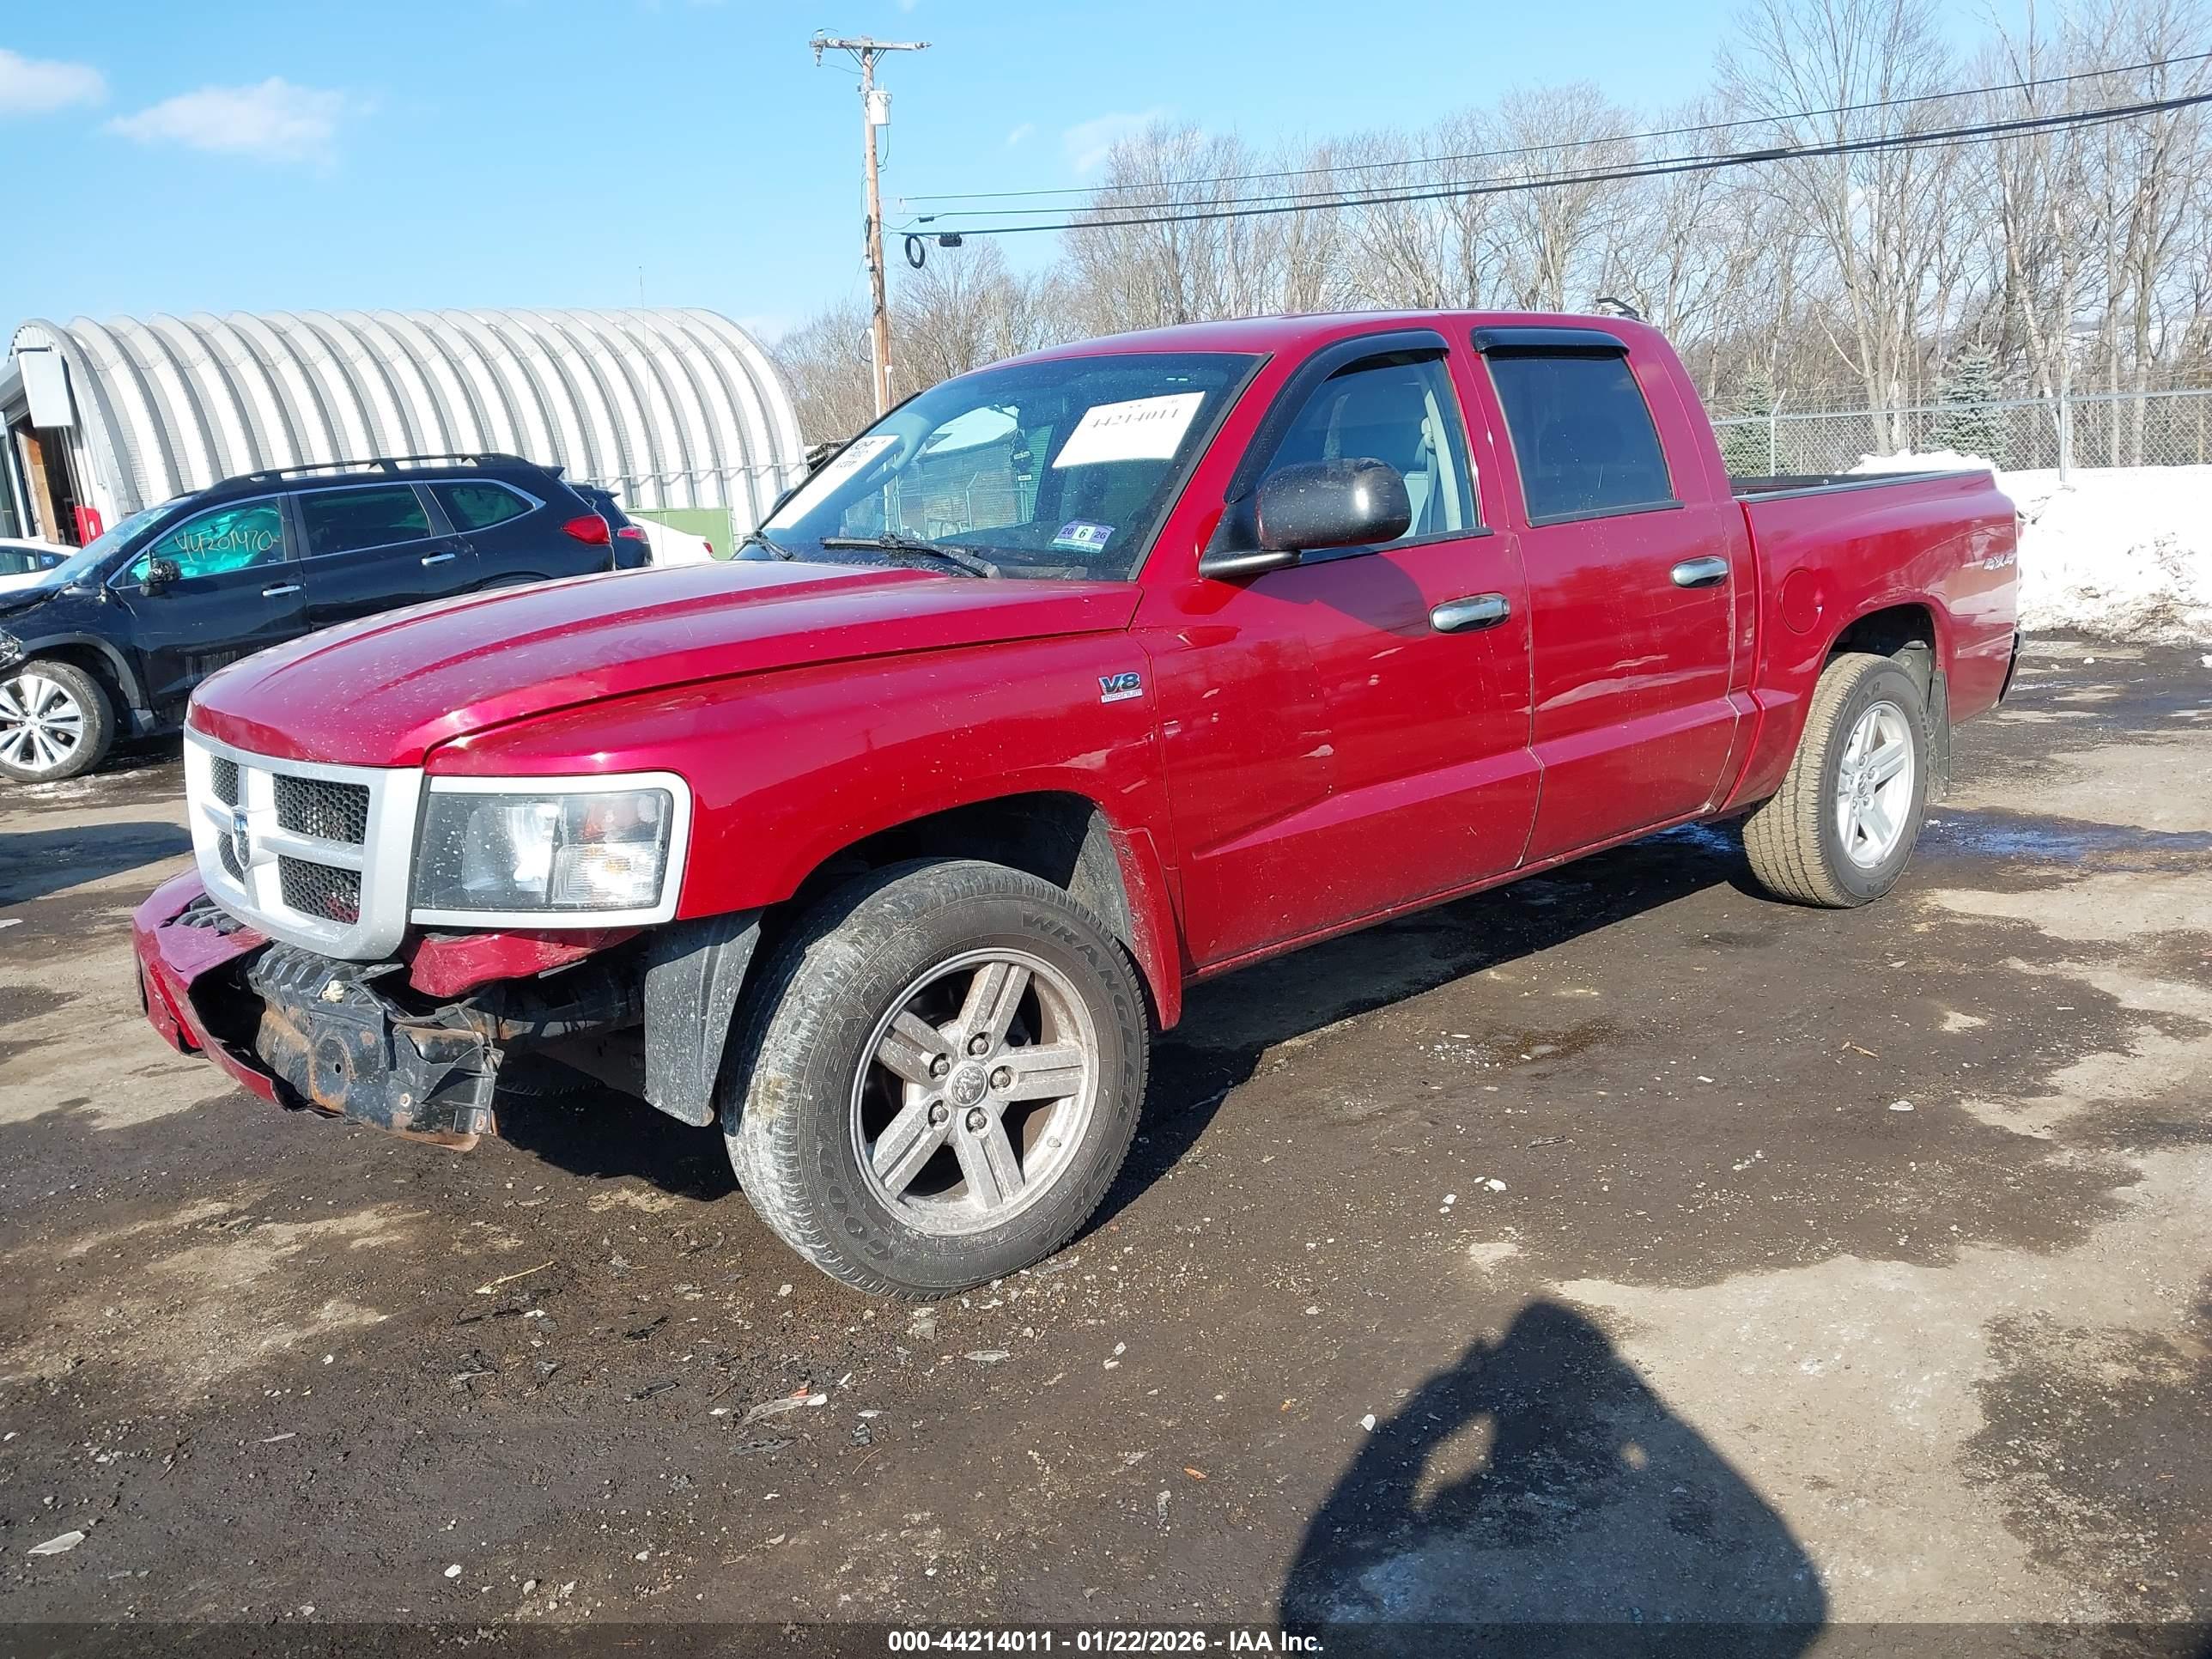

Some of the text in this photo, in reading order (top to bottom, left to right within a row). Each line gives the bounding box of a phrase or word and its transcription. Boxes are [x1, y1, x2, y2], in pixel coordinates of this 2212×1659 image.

[1078, 528, 1089, 538] 6
[1093, 531, 1108, 539] 26
[1098, 672, 1140, 695] V8
[1021, 911, 1136, 1121] WRANGLER
